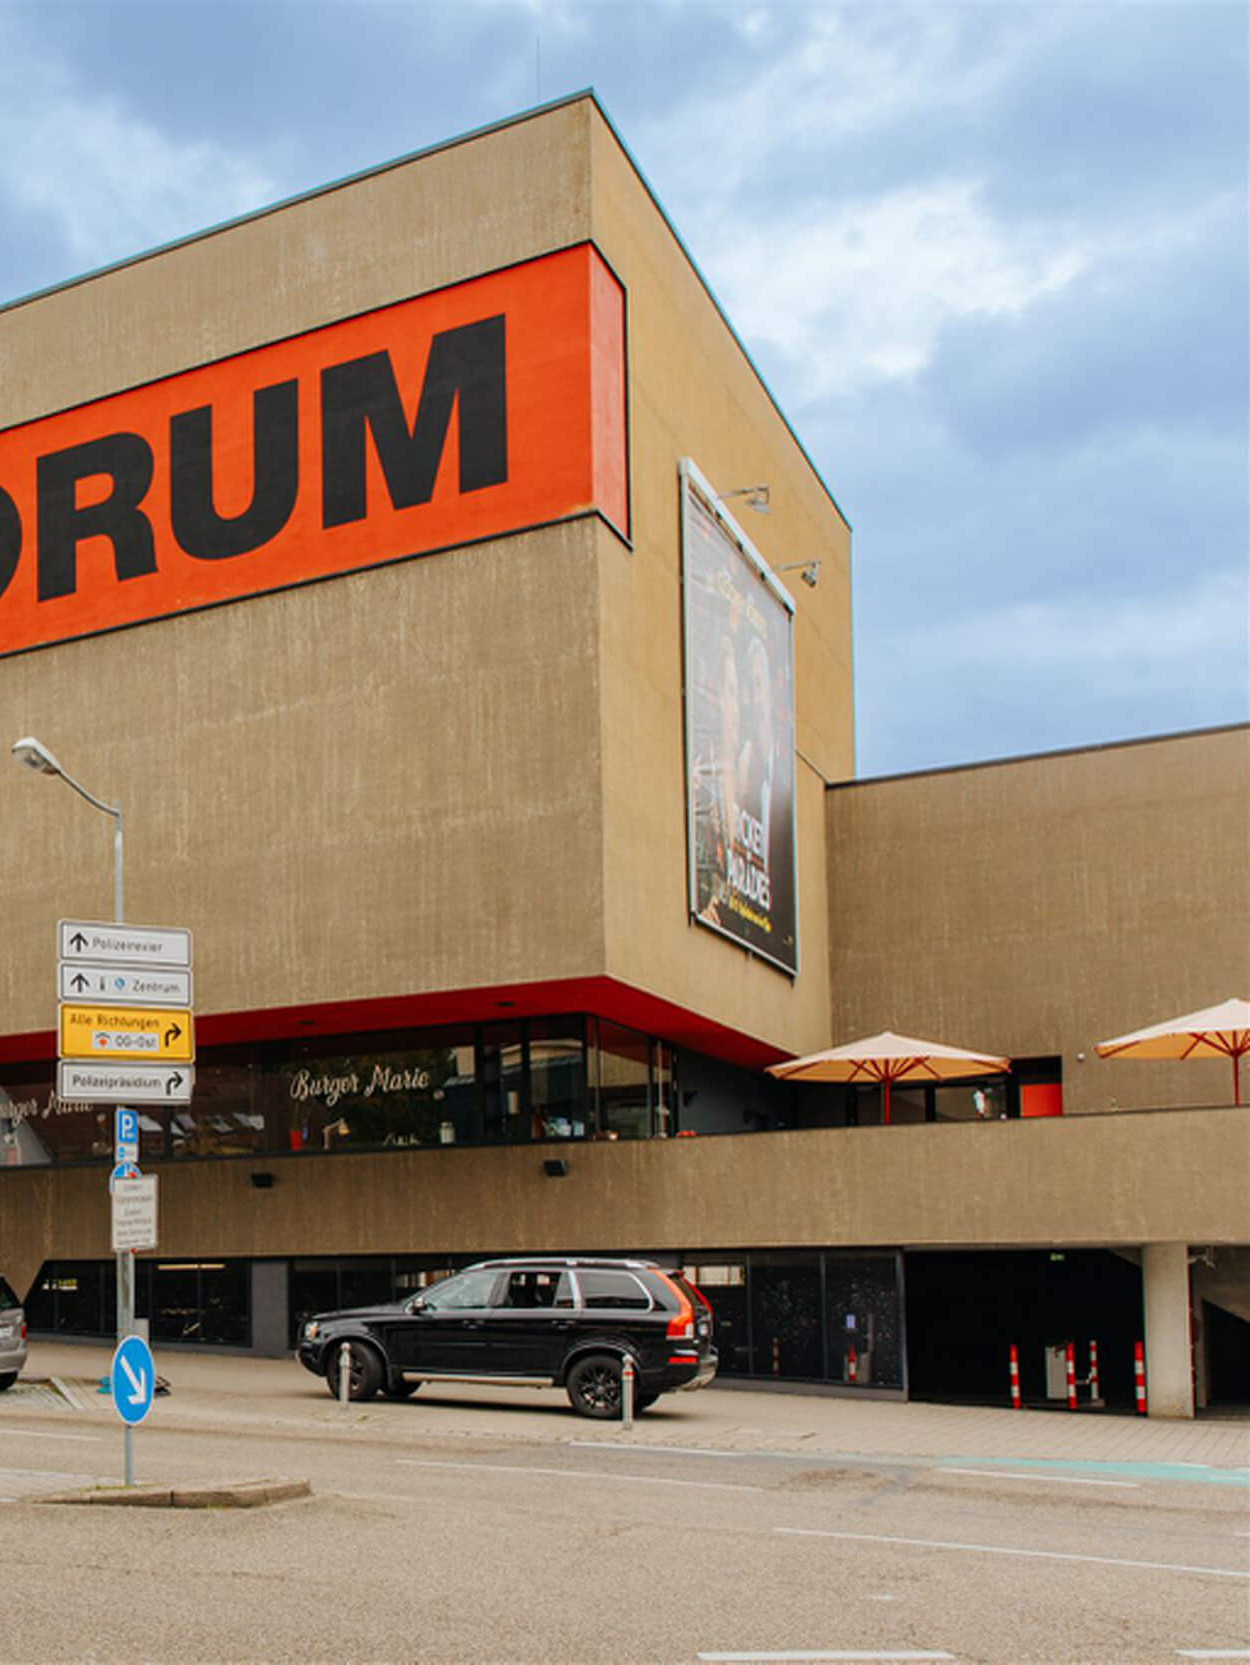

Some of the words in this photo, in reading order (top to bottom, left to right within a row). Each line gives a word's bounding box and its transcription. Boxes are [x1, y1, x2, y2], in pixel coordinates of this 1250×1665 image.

[92, 937, 163, 953] Polizeirevier
[132, 979, 180, 993] Zentrum
[70, 1013, 91, 1026] Alle
[97, 1015, 160, 1030] Richtungen
[72, 1073, 162, 1089] Polizeipräsidium
[290, 1068, 359, 1107] Burger
[364, 1064, 430, 1097] Marie
[121, 1114, 133, 1139] P
